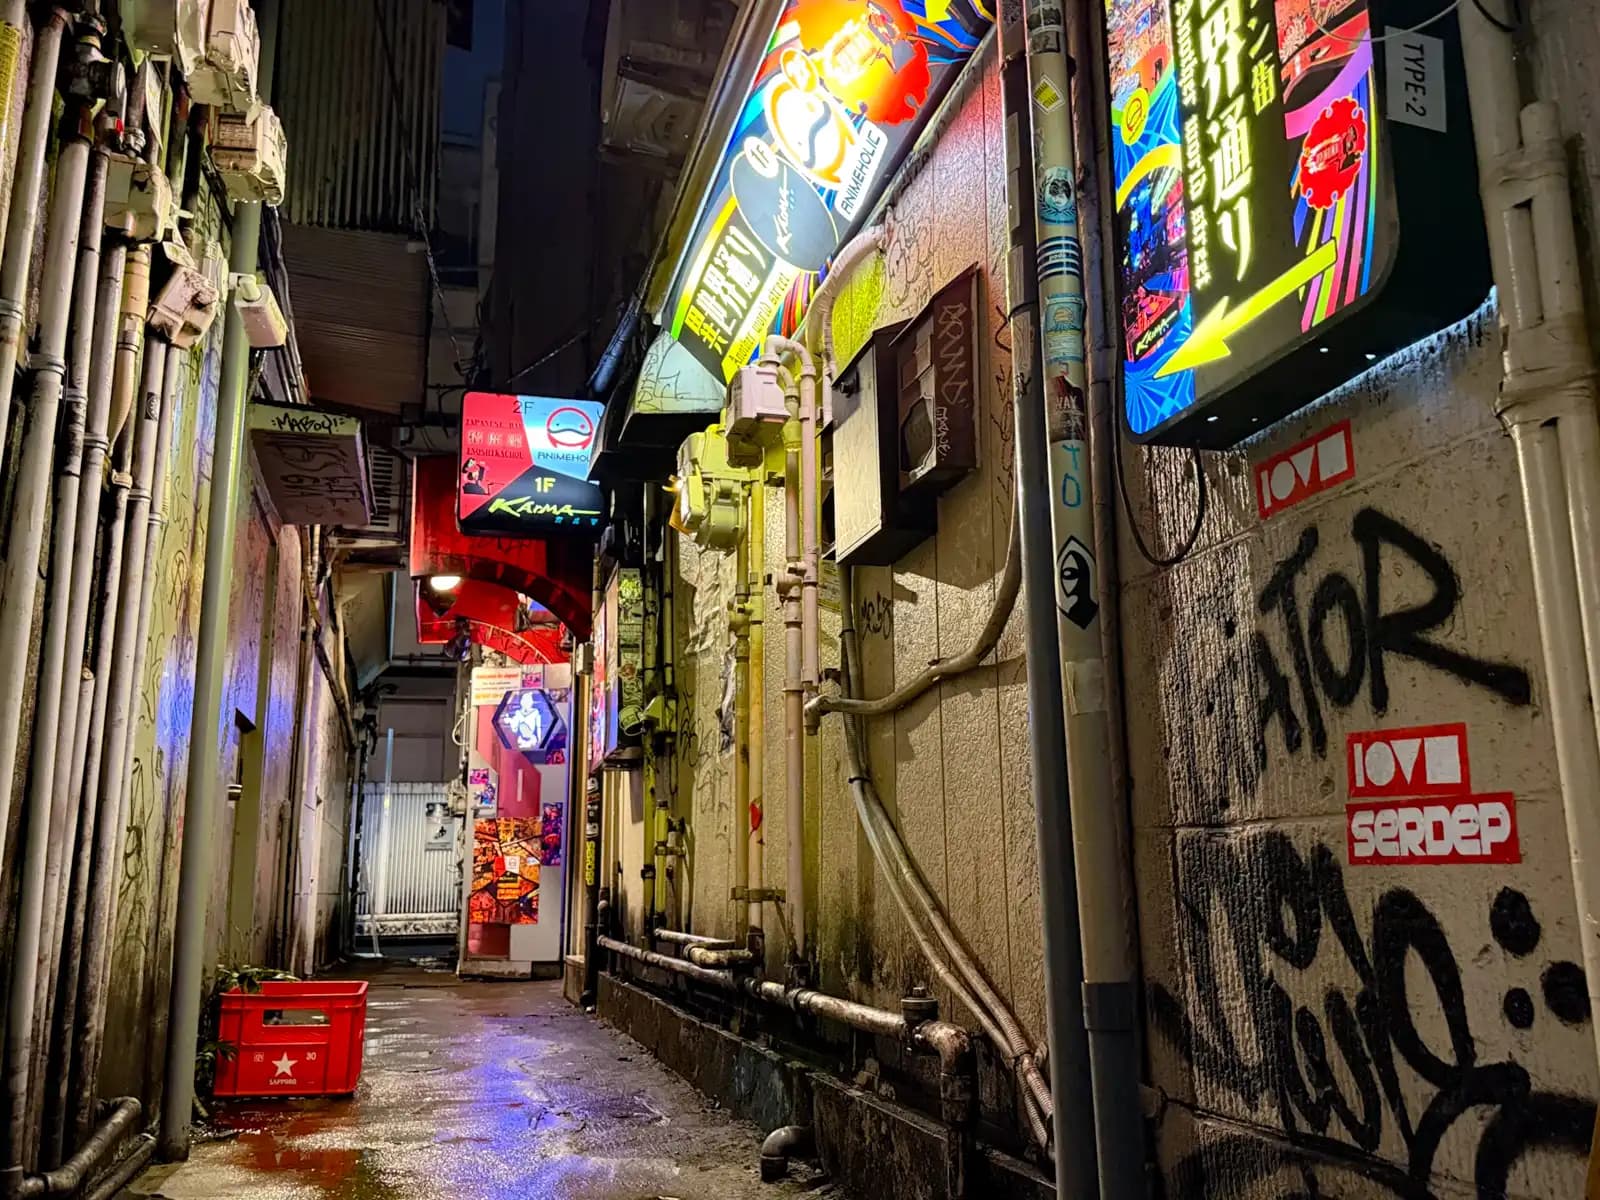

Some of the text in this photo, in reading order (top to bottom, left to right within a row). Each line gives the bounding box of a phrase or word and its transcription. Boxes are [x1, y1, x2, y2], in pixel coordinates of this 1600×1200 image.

[1198, 0, 1252, 282] 界通り
[750, 144, 769, 169] 1F
[841, 129, 881, 215] ANIMEHOLIC
[512, 400, 535, 414] 2F
[534, 476, 556, 493] 1F
